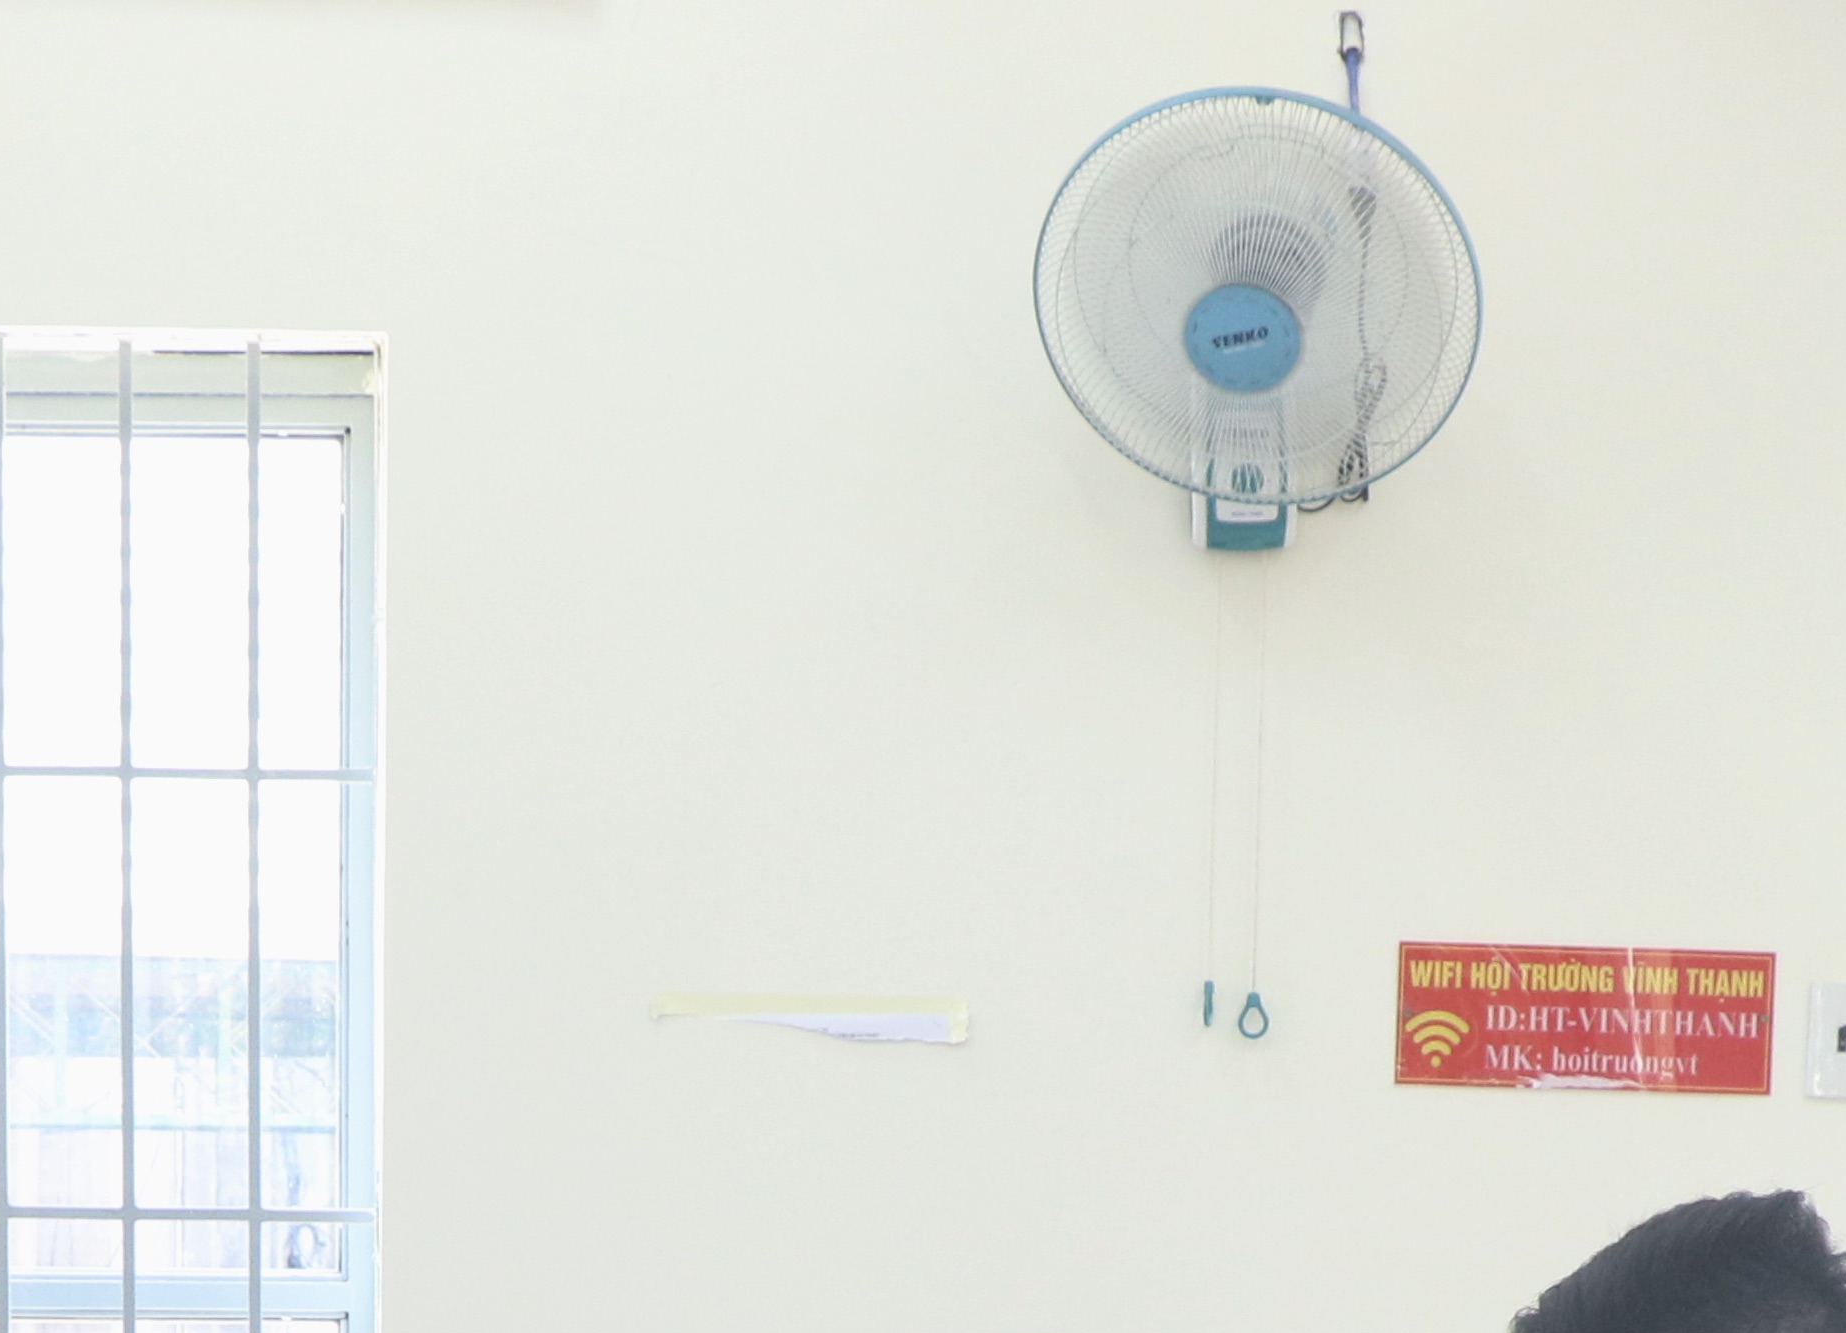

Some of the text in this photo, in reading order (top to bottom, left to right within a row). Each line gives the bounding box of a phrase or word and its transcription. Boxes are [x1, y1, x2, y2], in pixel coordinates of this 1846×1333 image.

[1213, 327, 1269, 348] VENKO
[1411, 957, 1764, 1003] WIFI HỘI TRƯỜNG VĨNH THẠNH
[1486, 1045, 1542, 1071] MK:
